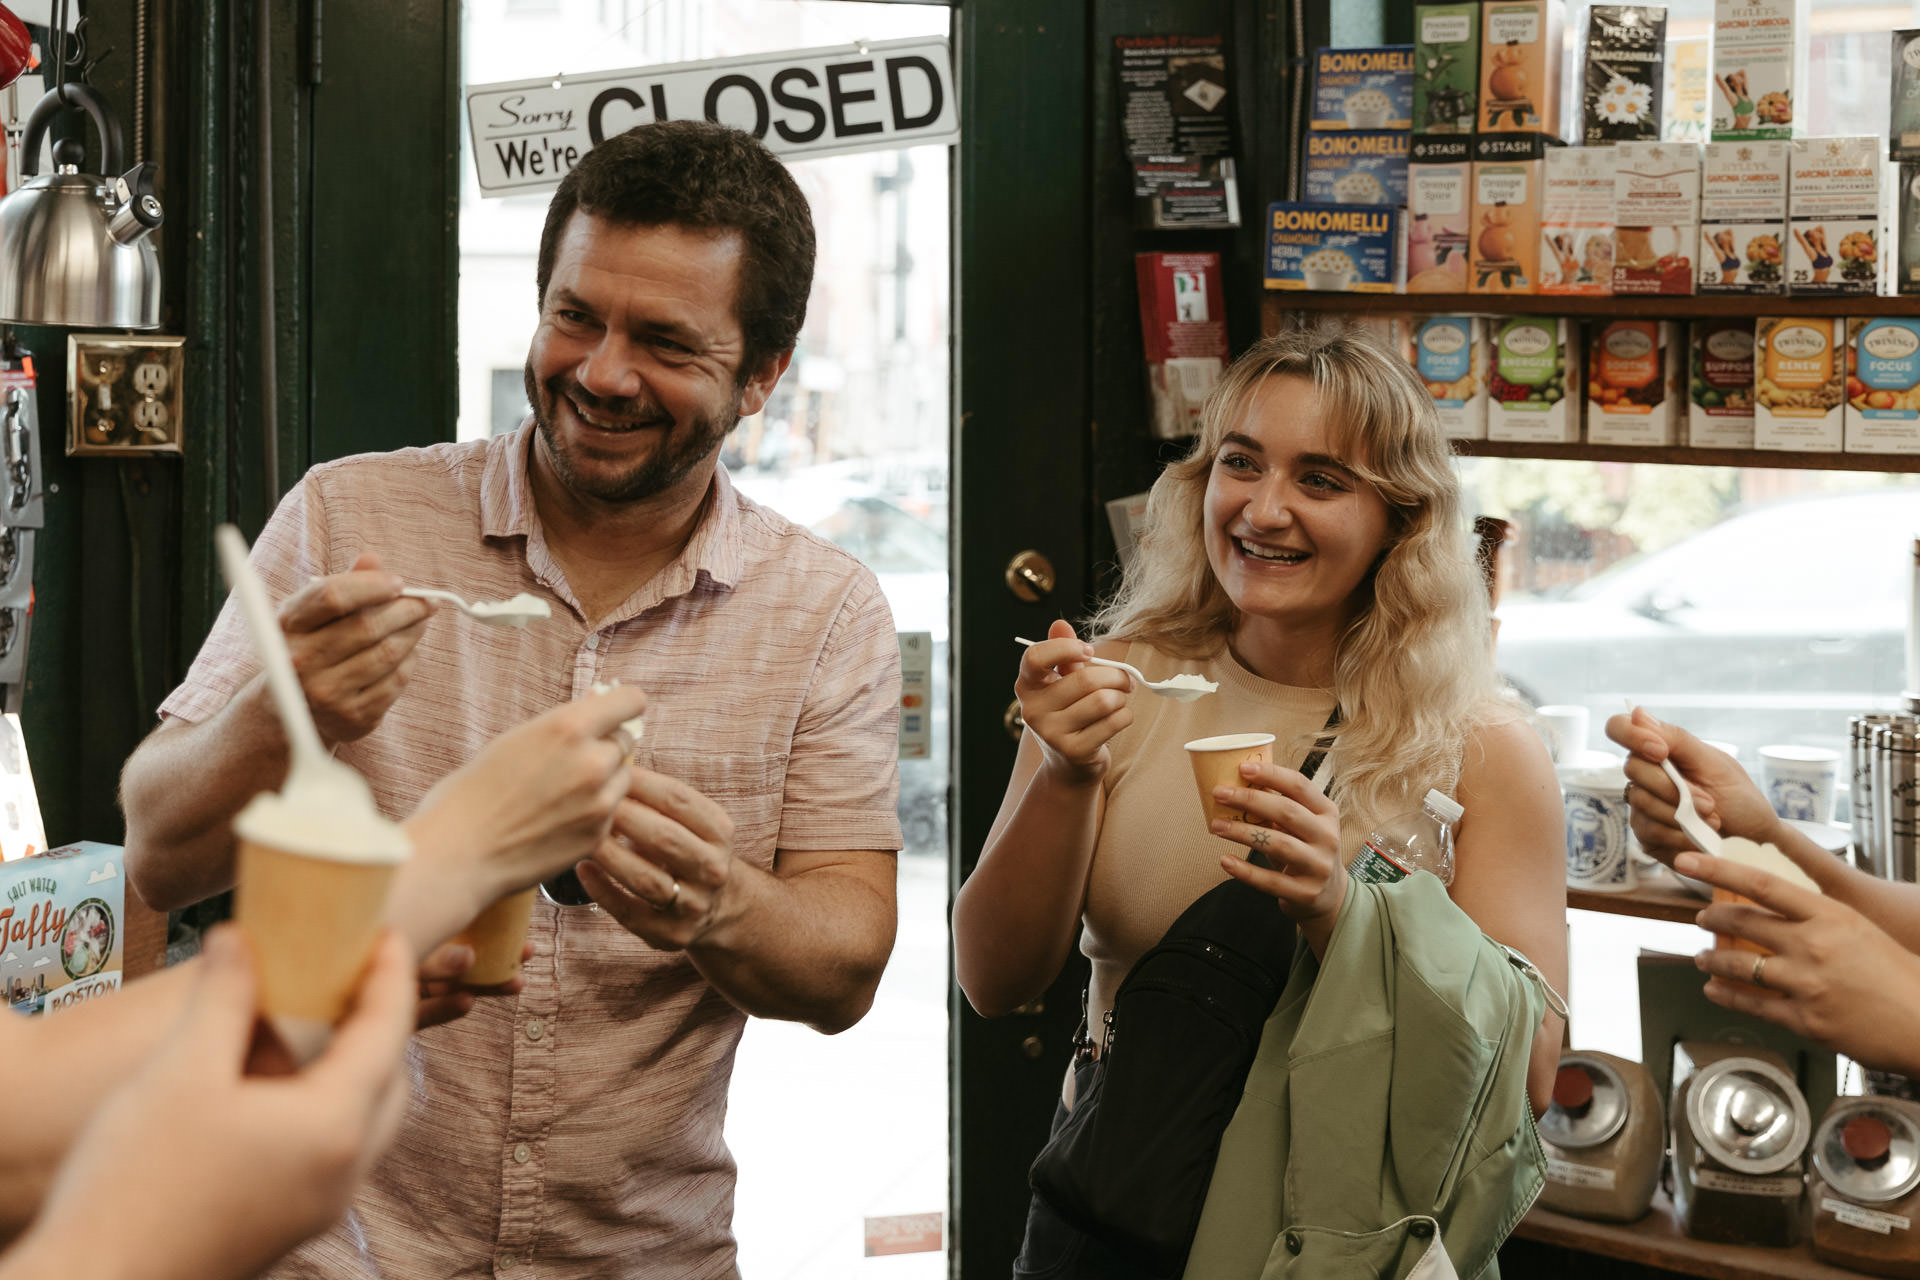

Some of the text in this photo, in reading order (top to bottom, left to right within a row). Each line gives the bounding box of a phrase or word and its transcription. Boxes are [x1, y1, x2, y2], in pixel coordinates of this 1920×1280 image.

[1319, 52, 1414, 73] BONOMELL
[488, 96, 575, 131] Sorry
[1427, 143, 1467, 155] STASH
[1491, 141, 1532, 153] STASH
[494, 137, 578, 179] We're
[1273, 210, 1389, 232] BONOMELLI
[1794, 270, 1808, 281] 25
[1777, 337, 1823, 349] TWININGS
[1867, 337, 1915, 349] TWININGS
[1426, 355, 1460, 365] FOCUS
[1501, 357, 1553, 368] ENERGIZE
[1777, 360, 1822, 371] RENEW
[1869, 361, 1913, 372] FOCUS
[7, 877, 57, 904] SALT WATER
[0, 898, 68, 955] Taffy
[51, 978, 118, 1014] BOSTON
